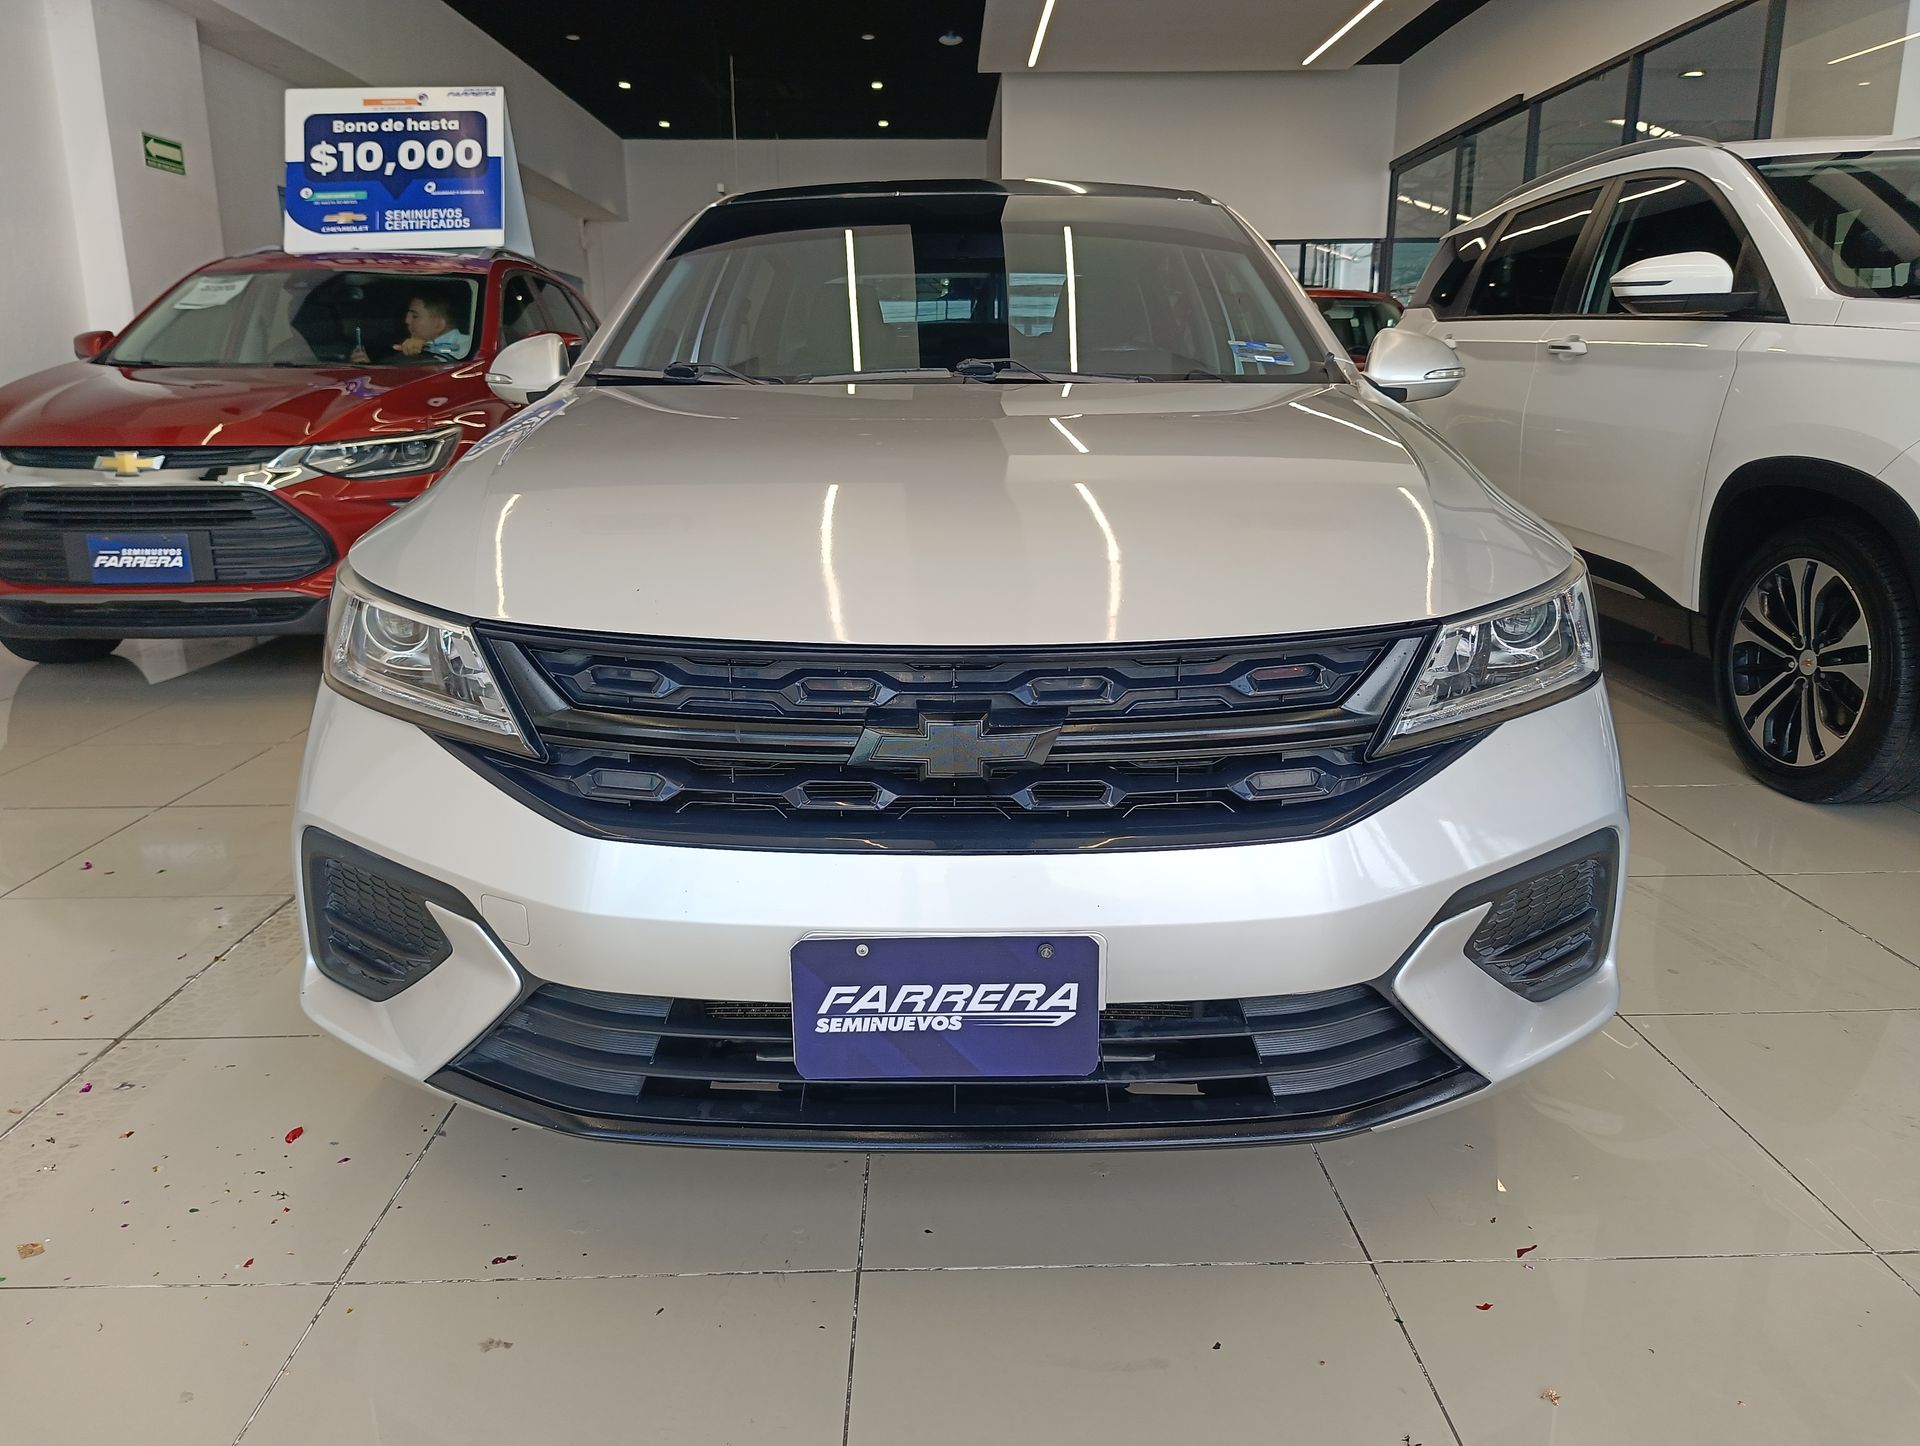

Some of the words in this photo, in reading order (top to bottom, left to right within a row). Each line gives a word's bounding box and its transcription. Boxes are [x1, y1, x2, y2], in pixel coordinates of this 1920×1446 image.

[332, 120, 379, 134] Bono
[381, 118, 404, 132] de
[407, 118, 460, 131] hasta
[309, 139, 483, 176] $10,000
[385, 208, 463, 220] SEMINUEVOS
[384, 218, 471, 231] CERTIFICADOS
[121, 548, 182, 556] SEMINUEVOS
[93, 556, 184, 568] FARRERA
[817, 983, 1079, 1014] FARRERA
[815, 1015, 963, 1033] SEMINUEVOS
